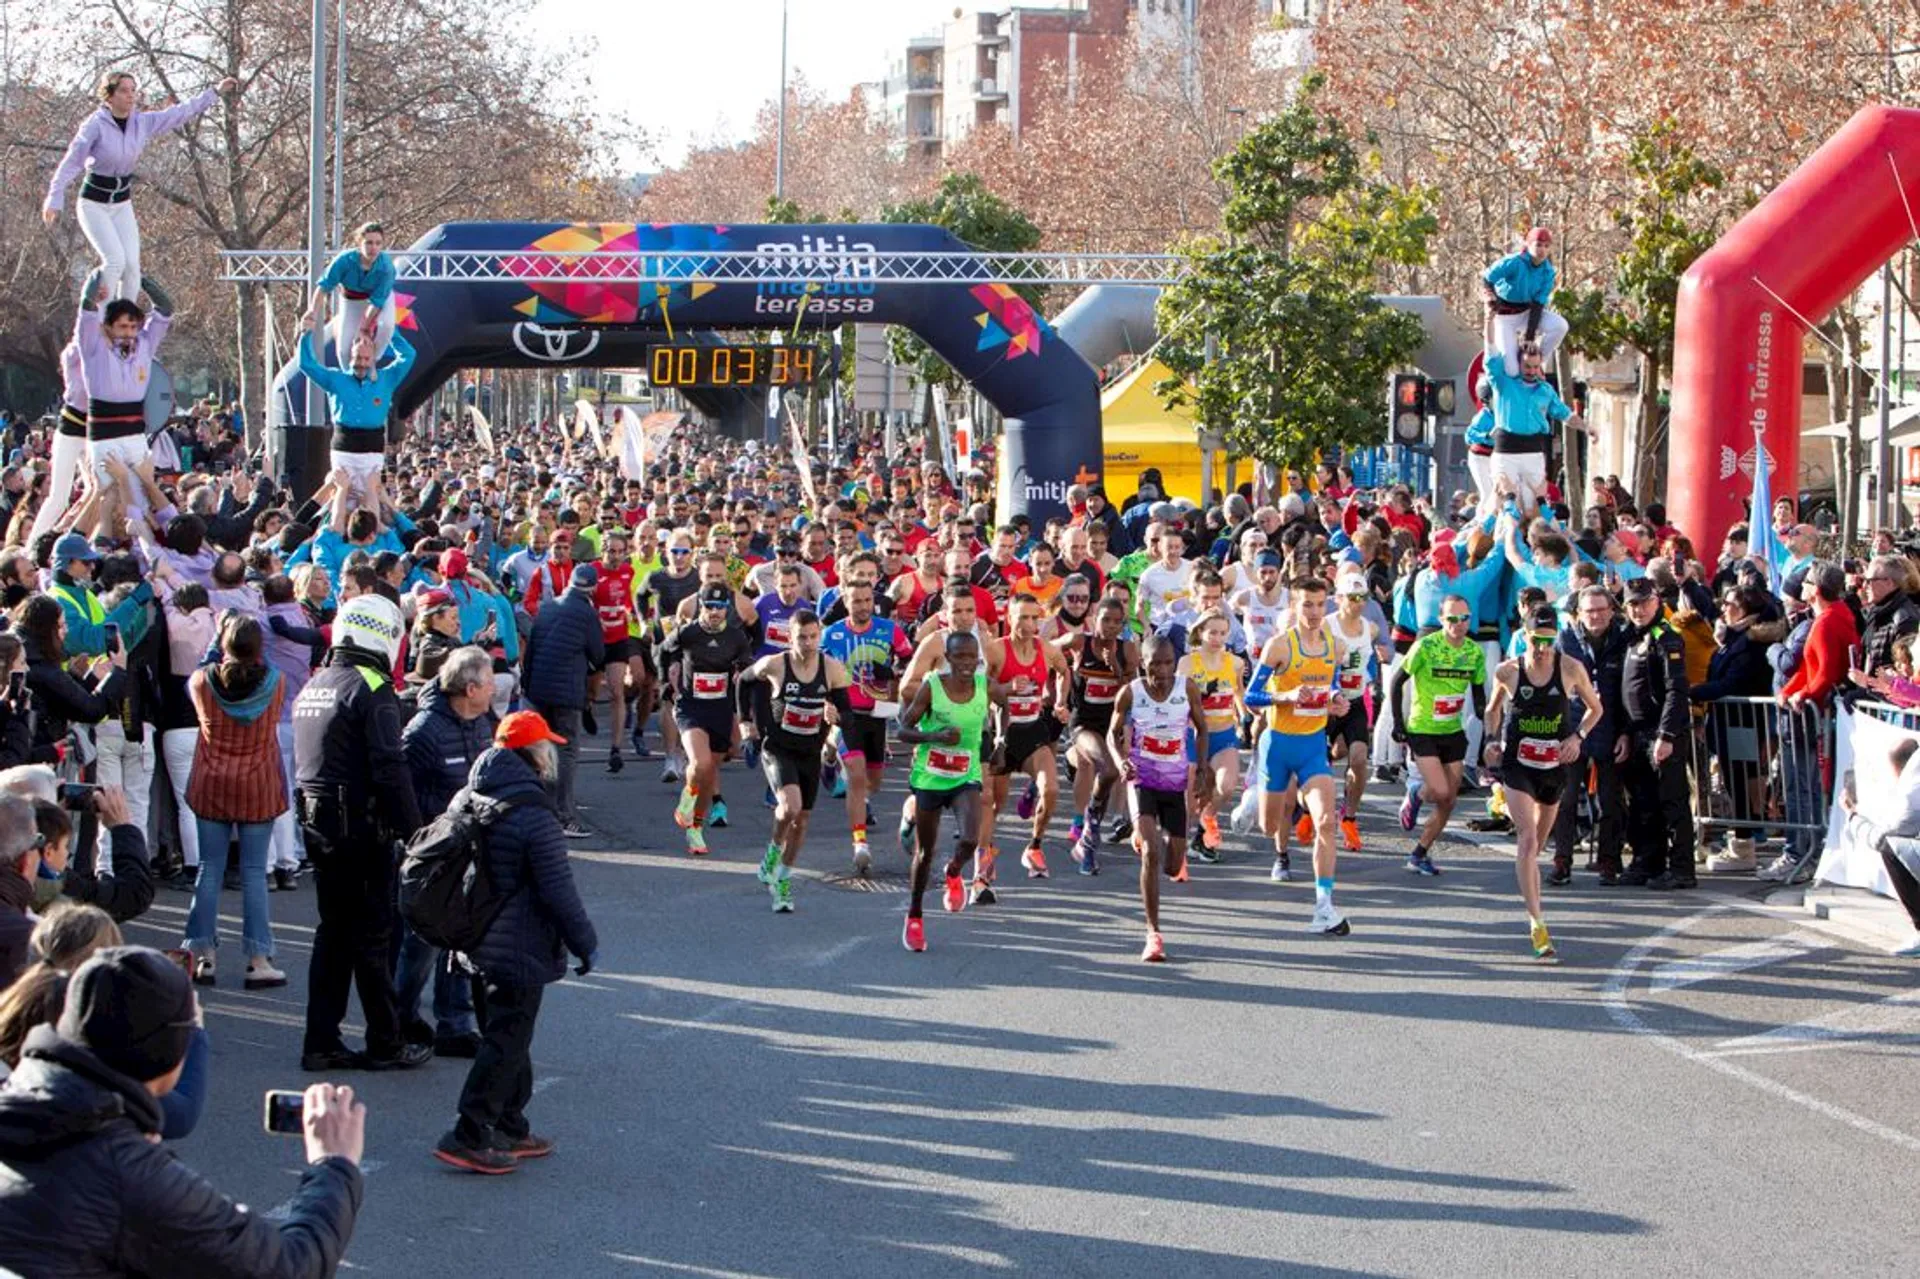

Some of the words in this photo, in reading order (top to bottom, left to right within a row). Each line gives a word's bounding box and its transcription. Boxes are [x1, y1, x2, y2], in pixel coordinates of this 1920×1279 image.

[756, 234, 877, 279] mitja
[755, 295, 875, 314] terassa
[653, 348, 697, 384] 00
[1750, 311, 1773, 402] Terrassa
[1749, 407, 1768, 434] de
[1024, 480, 1067, 505] mitj
